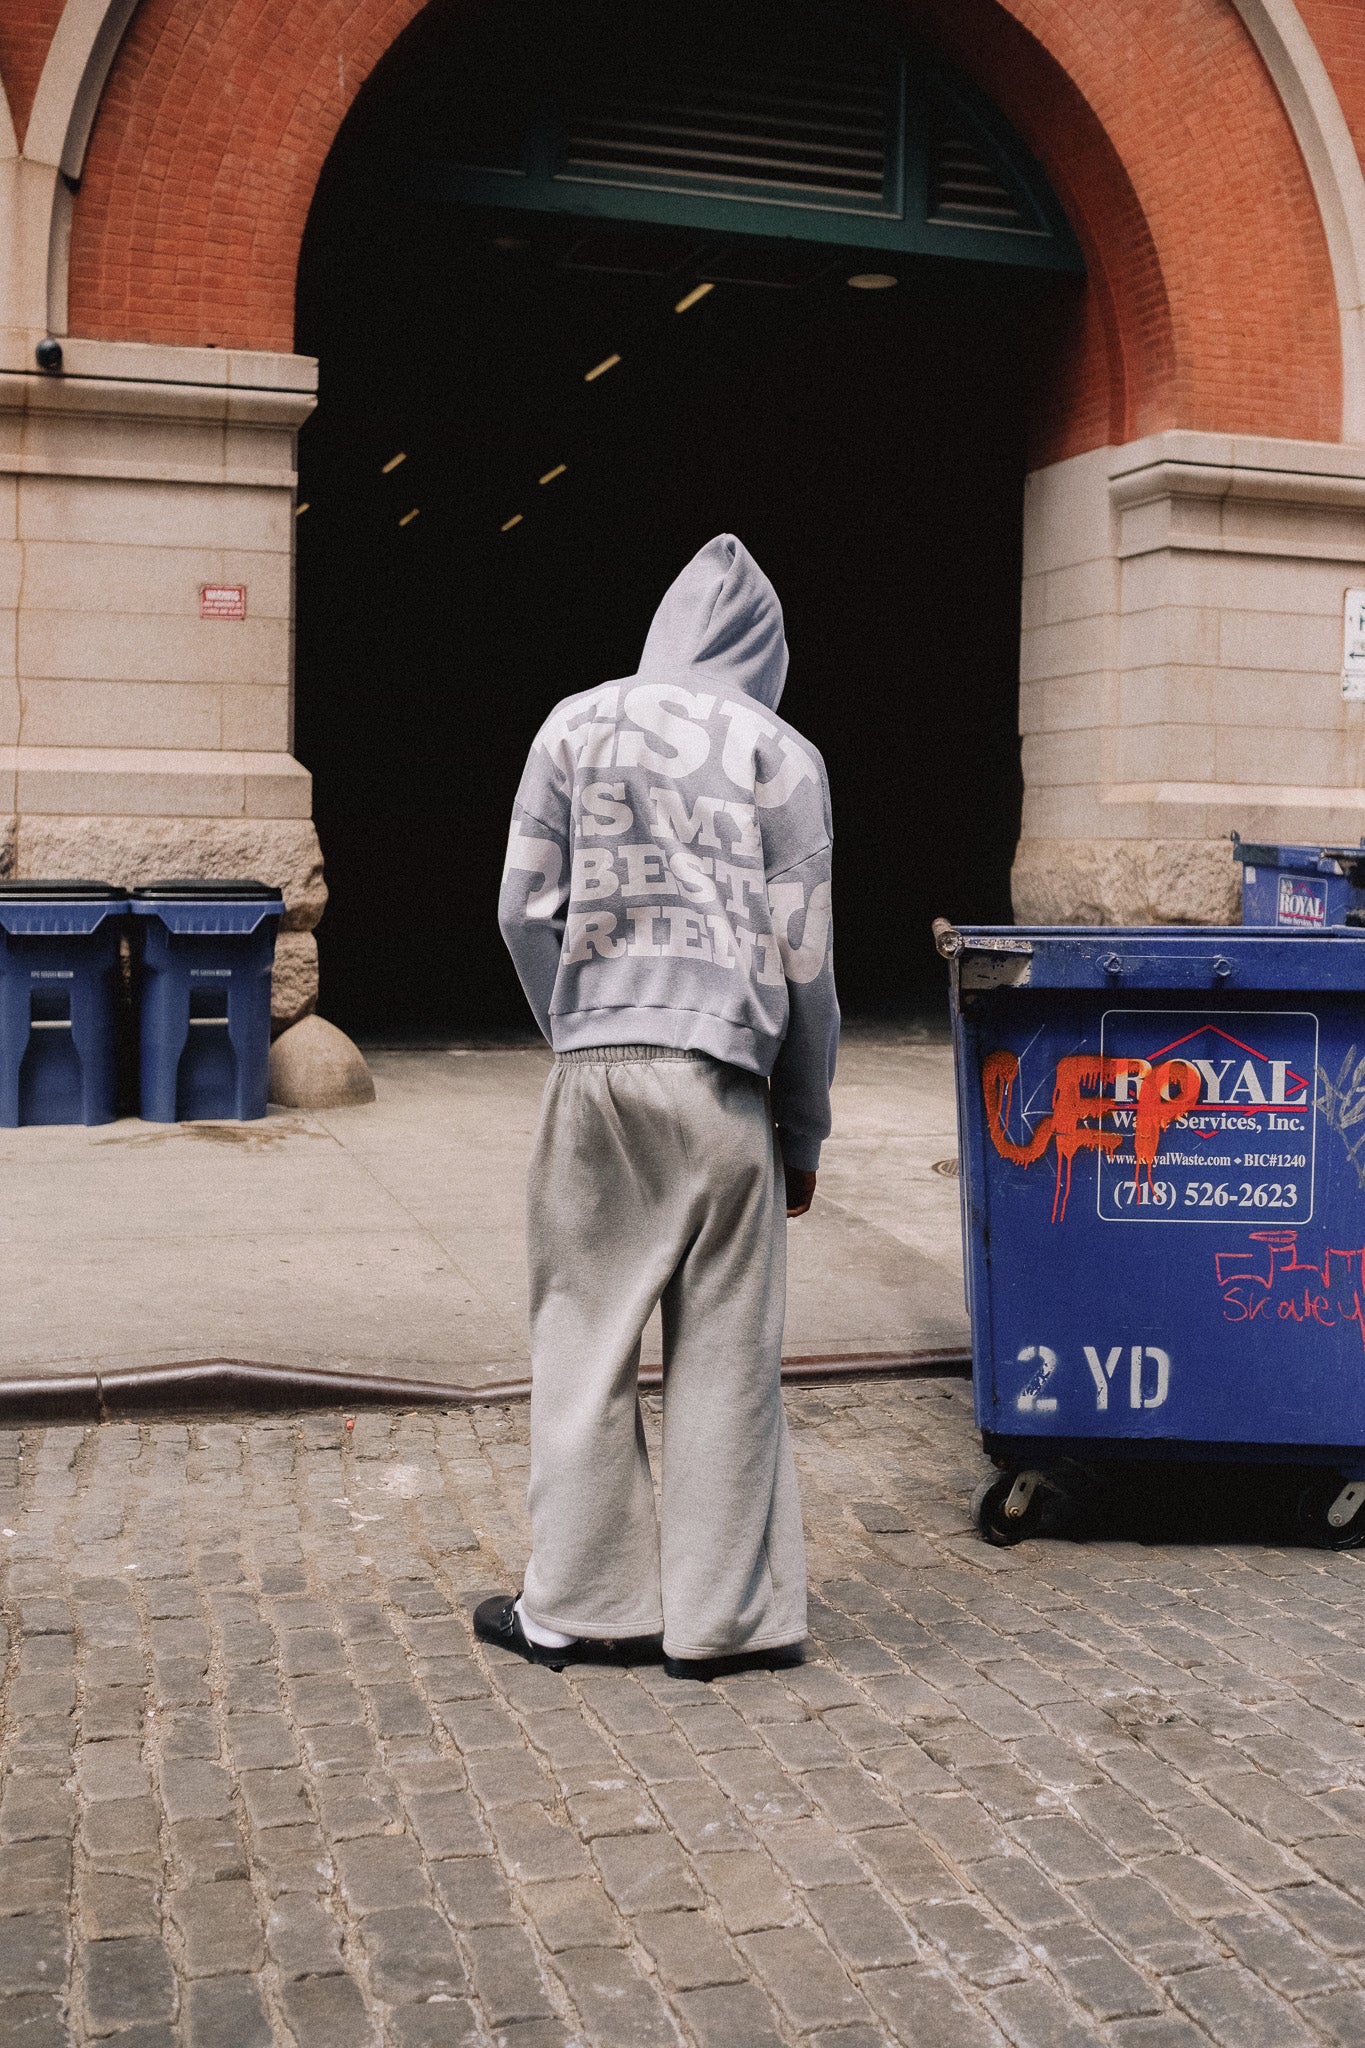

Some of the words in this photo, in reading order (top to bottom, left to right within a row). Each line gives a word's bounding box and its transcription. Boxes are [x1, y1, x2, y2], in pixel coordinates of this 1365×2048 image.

[650, 787, 762, 858] MY
[570, 843, 764, 920] BEST
[1279, 893, 1324, 919] ROYAL
[1111, 1058, 1307, 1104] ROYAL
[1176, 1112, 1262, 1133] Services,
[1268, 1113, 1305, 1131] Inc.
[1243, 1153, 1306, 1168] BIC#1240
[1113, 1180, 1177, 1210] (718)
[1184, 1182, 1298, 1207] 526-2623
[1017, 1345, 1057, 1412] 2
[1082, 1345, 1170, 1410] YD
